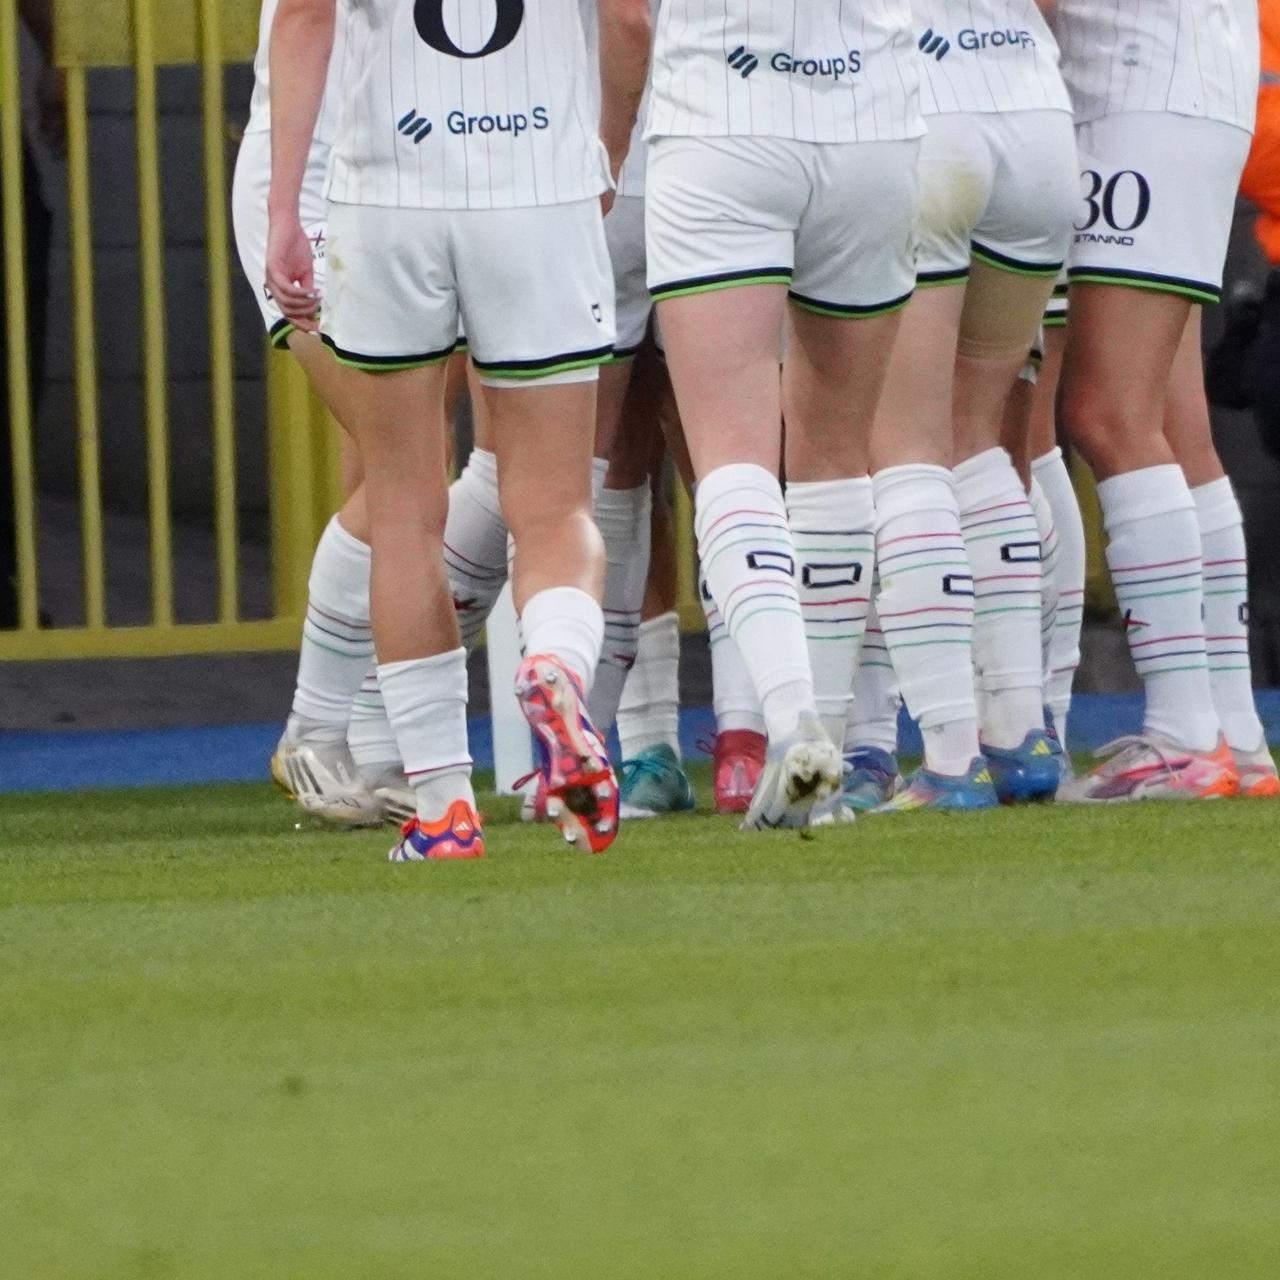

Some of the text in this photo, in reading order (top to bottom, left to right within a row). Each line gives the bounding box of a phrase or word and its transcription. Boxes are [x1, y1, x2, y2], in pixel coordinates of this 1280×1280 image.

[770, 52, 846, 81] Group
[447, 106, 549, 137] Group S
[1072, 170, 1150, 231] 30
